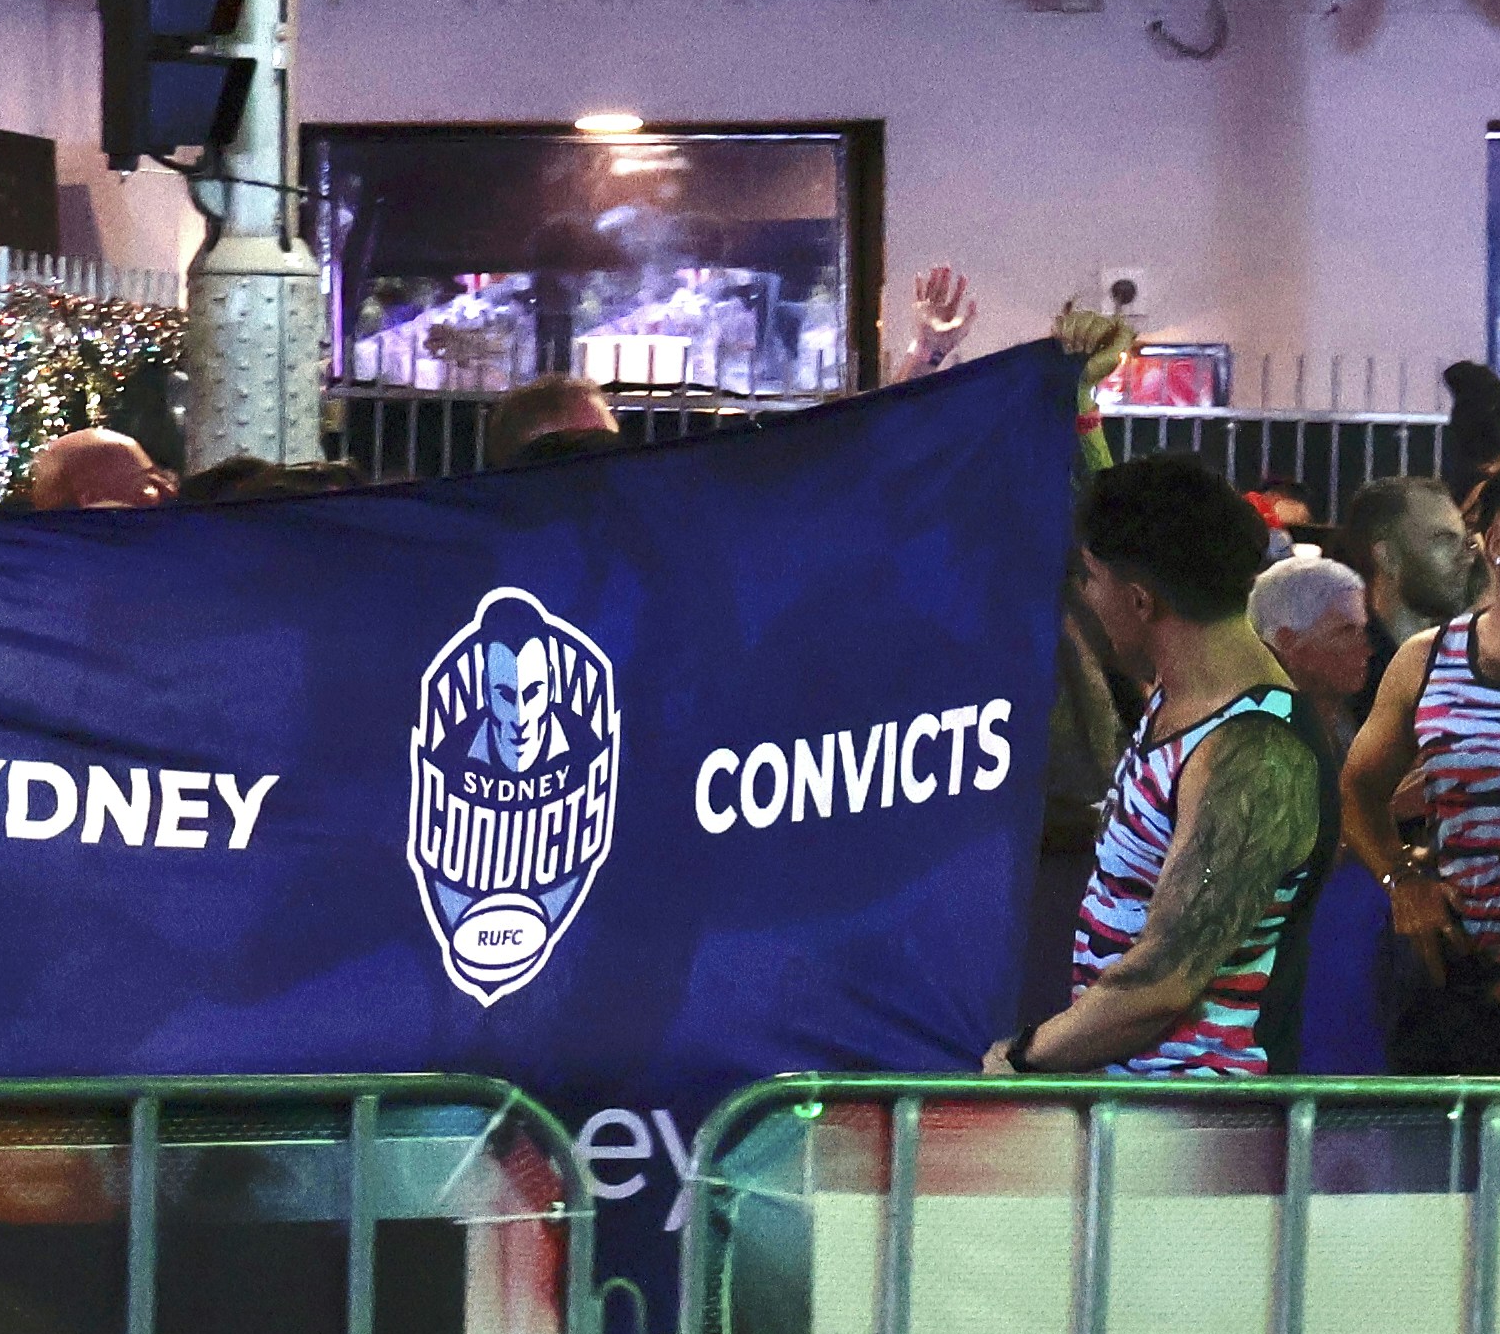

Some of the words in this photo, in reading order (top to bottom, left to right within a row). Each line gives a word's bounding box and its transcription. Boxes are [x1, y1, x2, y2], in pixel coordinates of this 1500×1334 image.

[463, 764, 571, 802] SYDNEY
[694, 698, 1012, 836] CONVICTS
[419, 747, 610, 892] CONVICTS
[477, 928, 525, 947] RUFC
